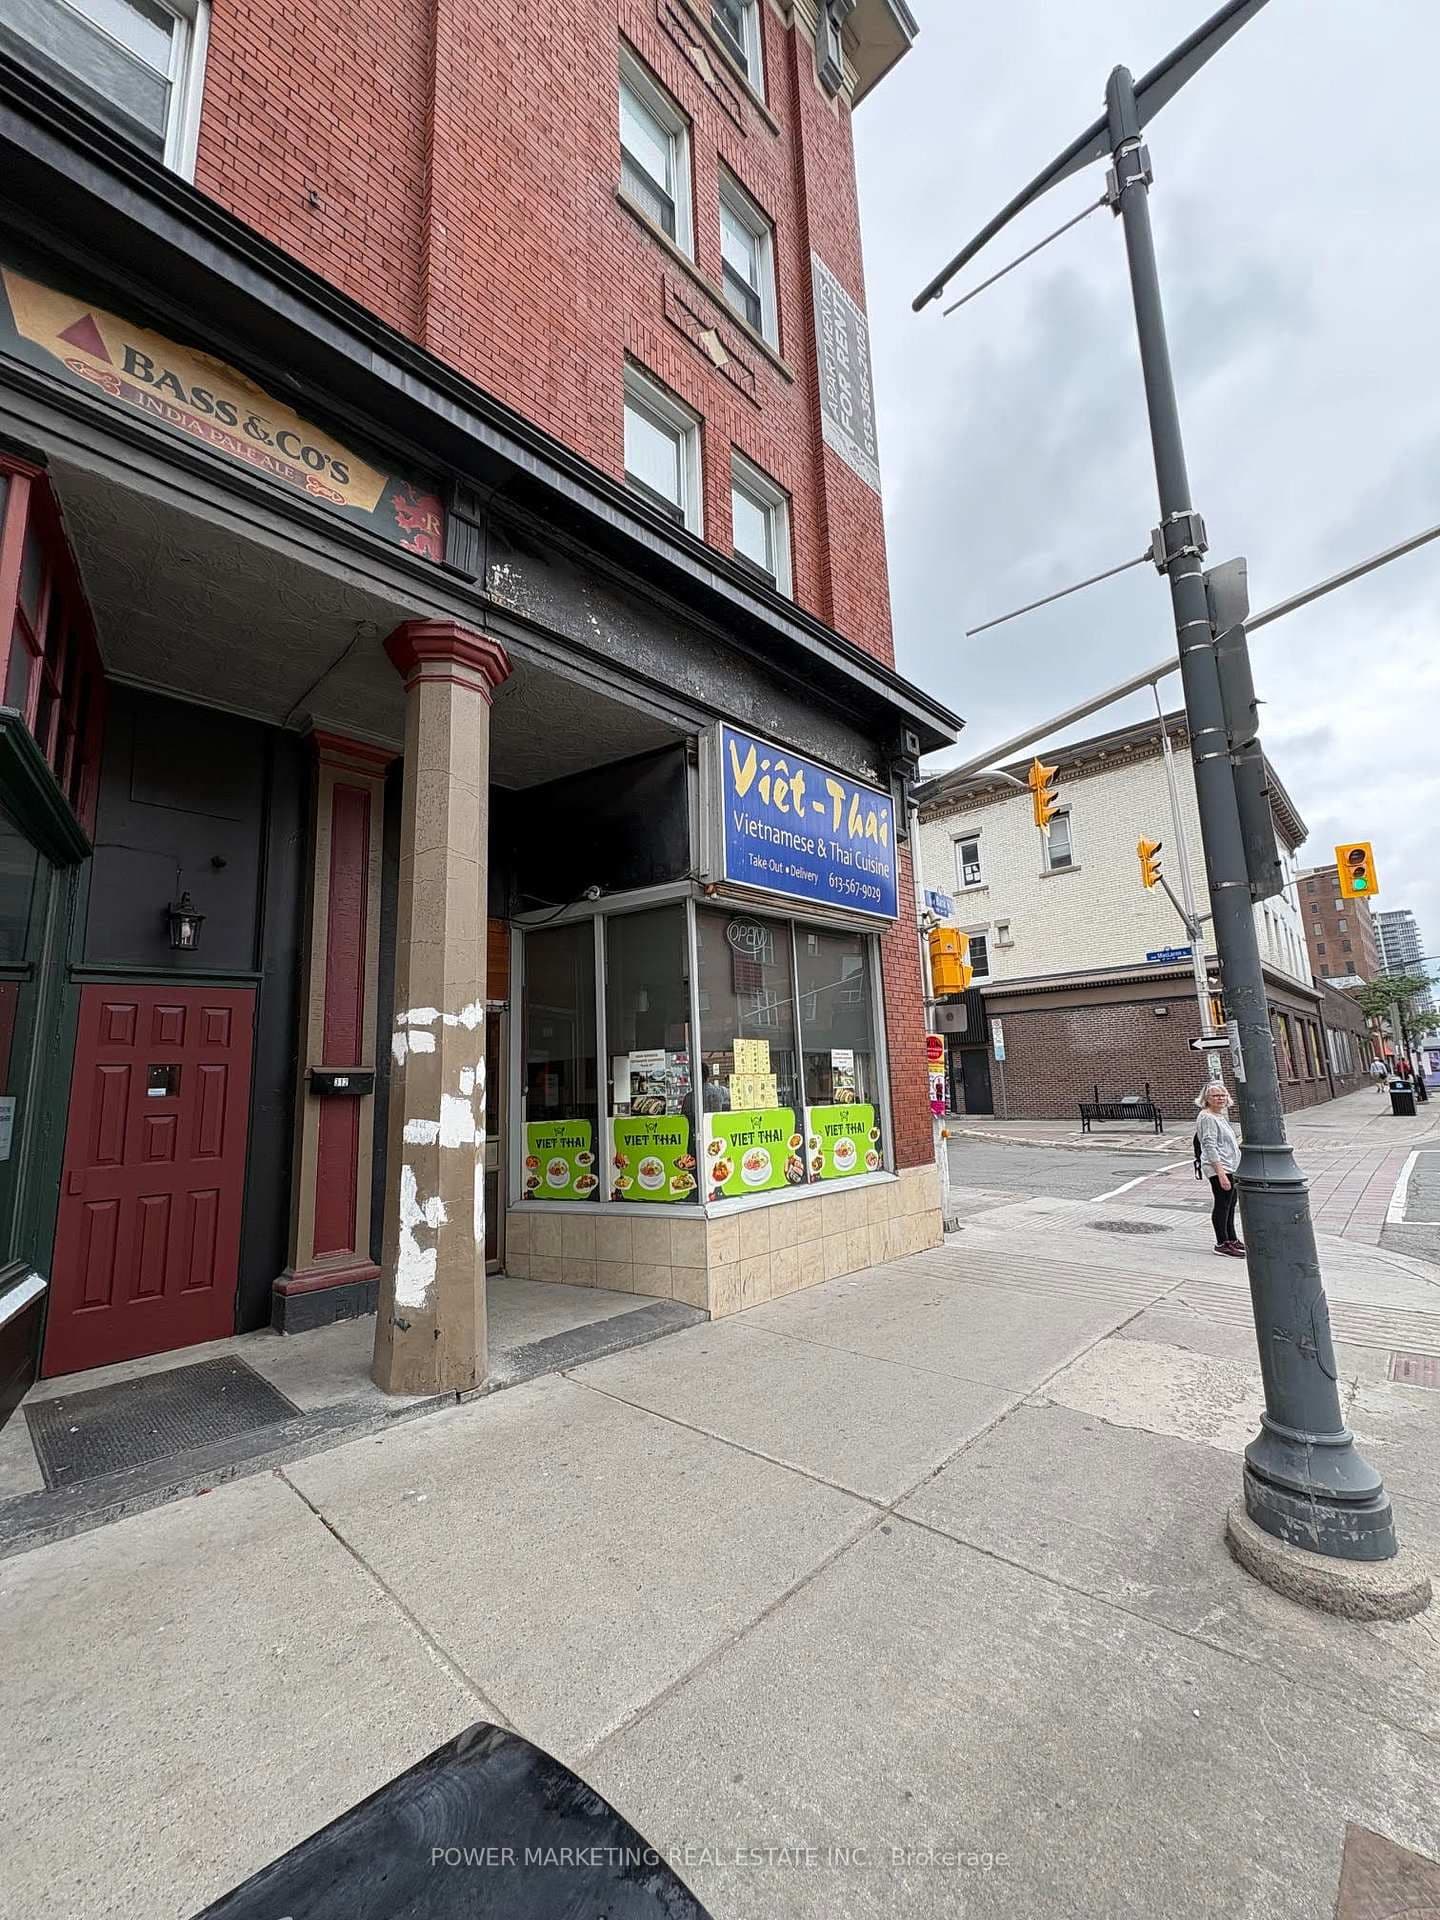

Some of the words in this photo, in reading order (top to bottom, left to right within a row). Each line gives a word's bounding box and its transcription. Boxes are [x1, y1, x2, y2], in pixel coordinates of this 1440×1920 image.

[820, 278, 840, 419] APARTMENTS
[832, 292, 850, 373] RENT
[838, 372, 855, 436] FOR
[137, 391, 205, 434] INDIA
[210, 427, 257, 458] PALE
[261, 455, 296, 480] ALE
[733, 810, 815, 855] Vietnamese
[817, 838, 828, 859] &
[829, 841, 853, 866] Thai
[855, 851, 890, 878] Cuisine
[748, 853, 767, 869] Take
[769, 858, 783, 873] Out
[790, 864, 818, 885] Delivery
[828, 872, 881, 902] 613-567-9029
[729, 924, 765, 945] OPEN
[536, 1138, 557, 1149] VIET
[560, 1136, 585, 1148] THAI
[624, 1134, 649, 1146] VIET
[652, 1133, 681, 1145] THAI
[730, 1131, 755, 1147] VIET
[759, 1129, 783, 1143] THAI
[825, 1124, 843, 1137] VIET
[846, 1121, 865, 1134] THAI
